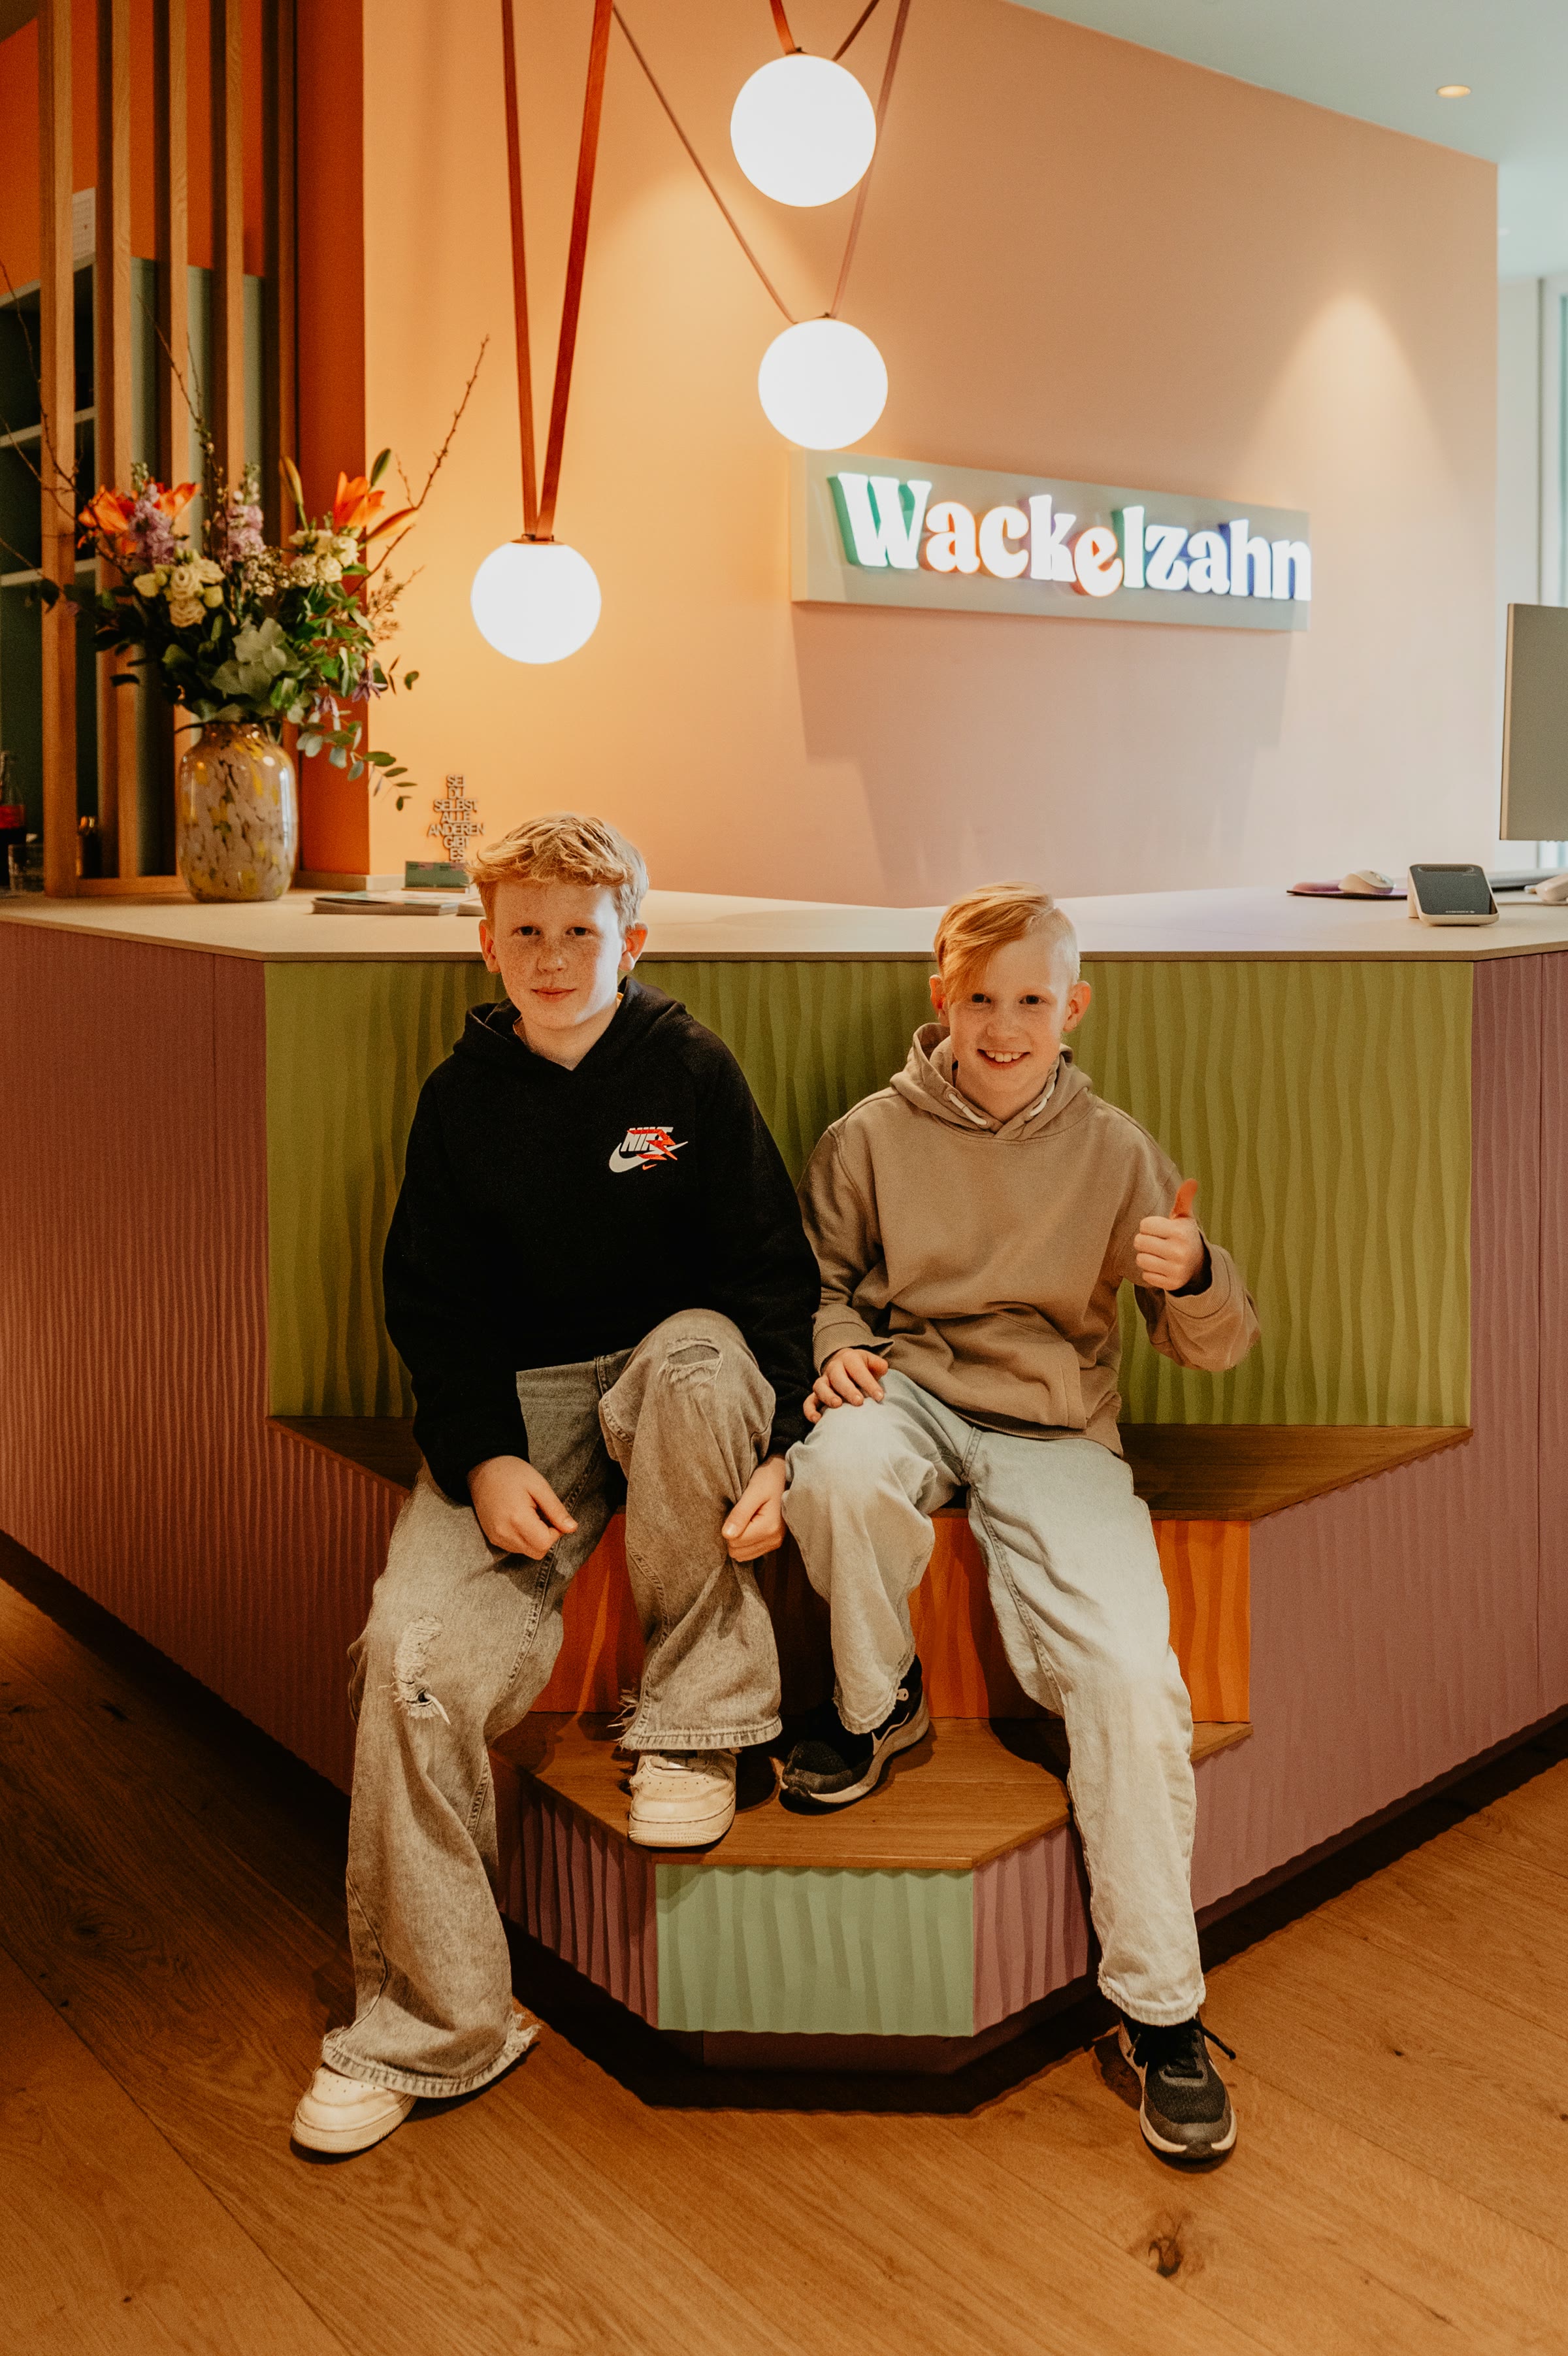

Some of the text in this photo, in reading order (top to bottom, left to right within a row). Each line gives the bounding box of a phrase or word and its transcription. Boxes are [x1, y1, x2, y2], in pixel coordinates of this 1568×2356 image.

[829, 472, 1311, 600] Wackelzahn
[447, 775, 465, 787] SEI
[448, 787, 465, 799] DU
[440, 811, 470, 823] ALLE
[428, 823, 485, 837] ANDEREN
[444, 836, 470, 849] GIBT
[449, 848, 465, 860] ES
